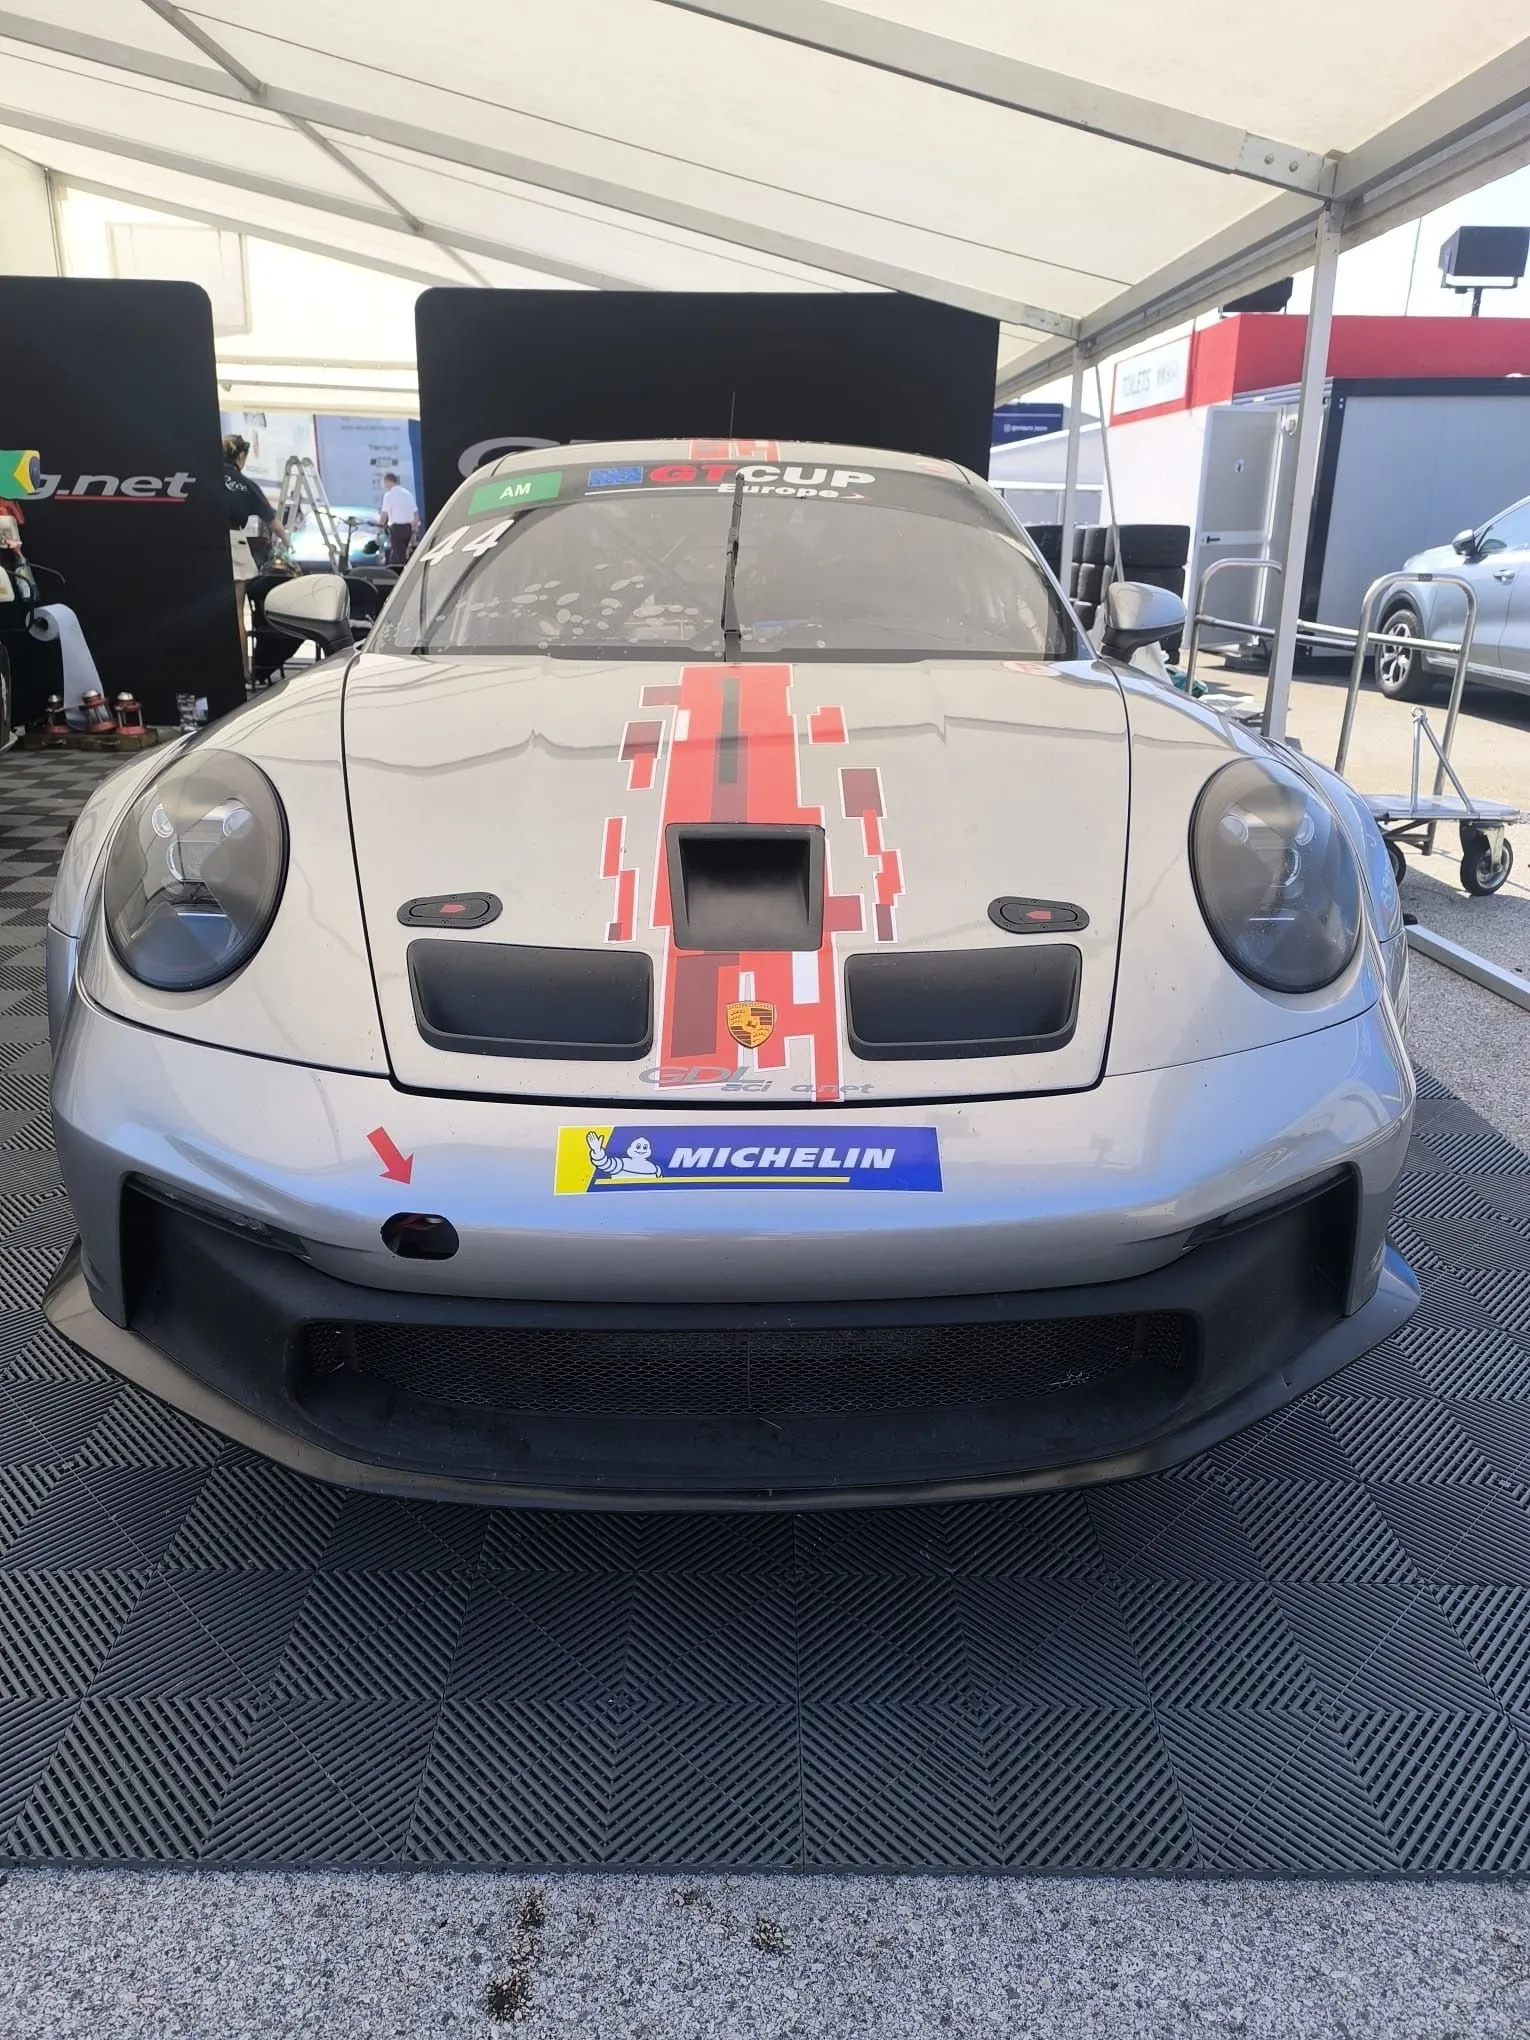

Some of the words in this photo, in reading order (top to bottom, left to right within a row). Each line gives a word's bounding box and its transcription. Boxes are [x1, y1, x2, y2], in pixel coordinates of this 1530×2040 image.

[500, 482, 532, 500] AM
[717, 483, 839, 498] Europe
[419, 519, 515, 566] 44
[639, 1066, 767, 1084] GDL
[667, 1147, 896, 1170] MICHELIN
